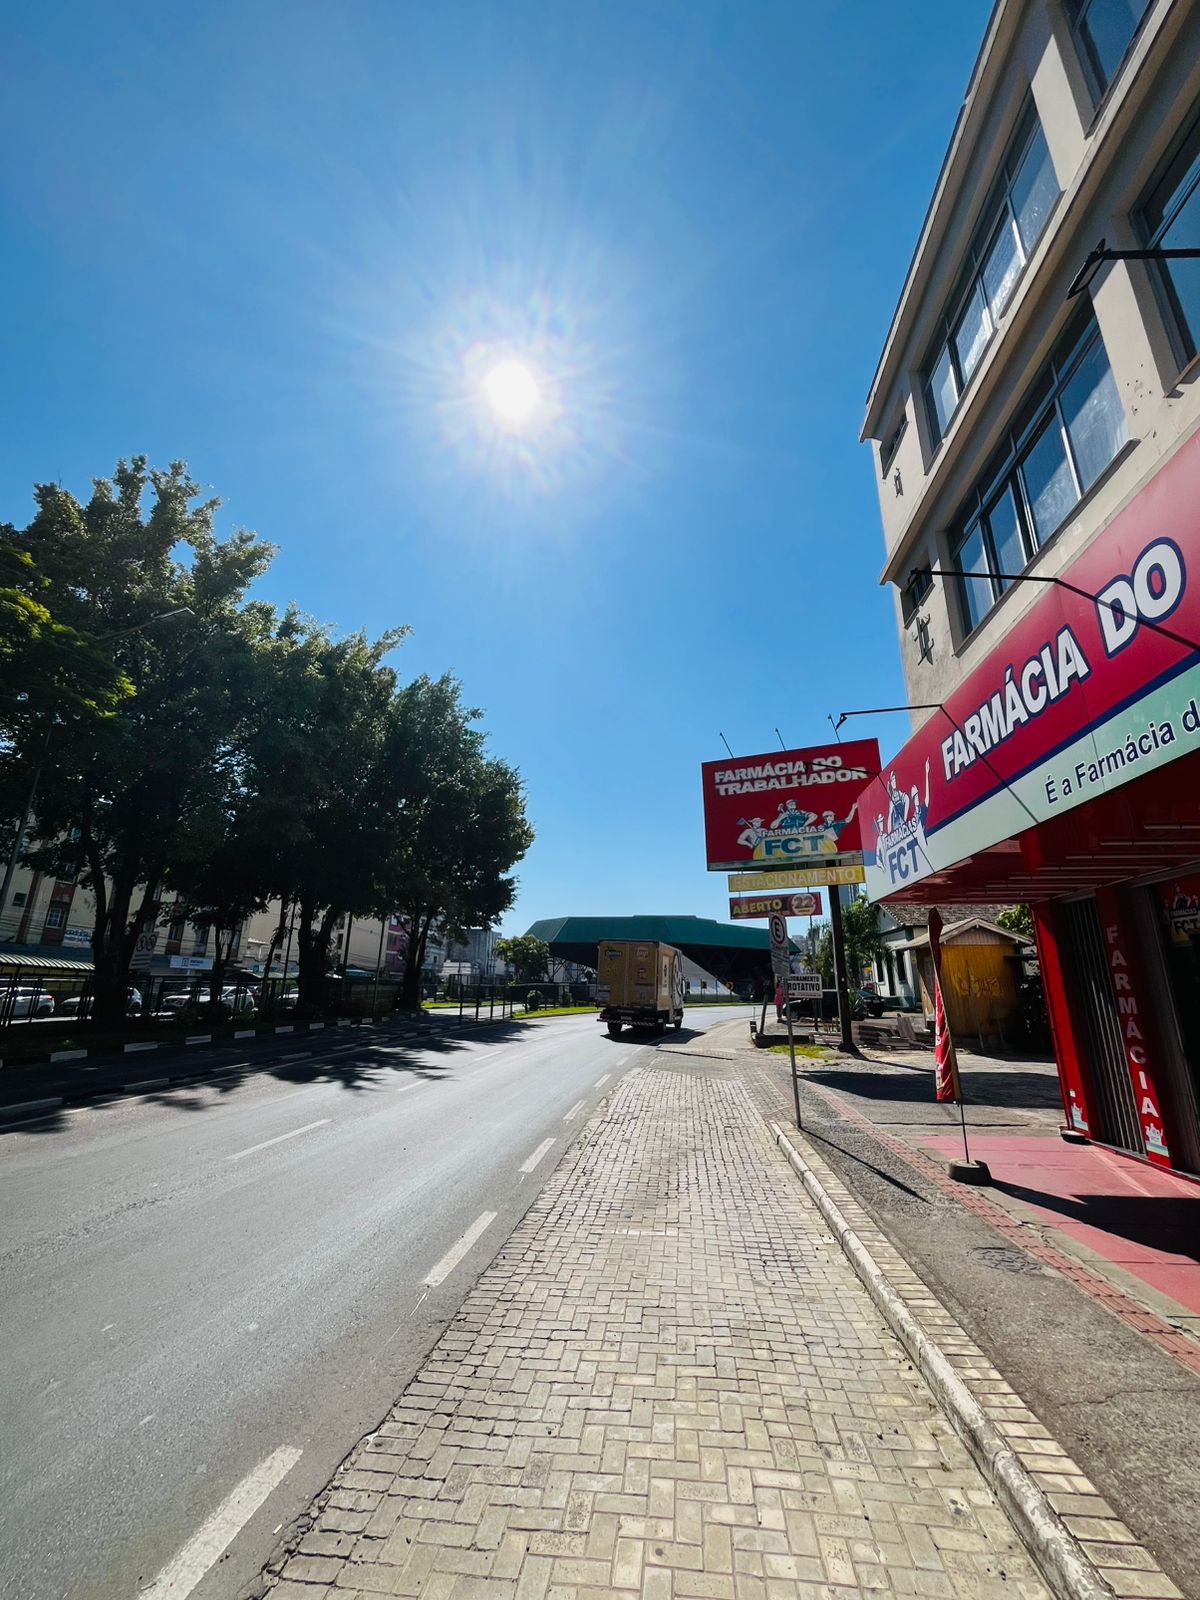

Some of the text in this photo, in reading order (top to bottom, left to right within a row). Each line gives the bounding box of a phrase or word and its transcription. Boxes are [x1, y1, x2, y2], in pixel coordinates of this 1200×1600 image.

[940, 540, 1184, 782] FARMÁCIA DO
[1045, 699, 1200, 803] É a Farmácia d
[714, 755, 842, 784] FARMÁCIA DO
[715, 767, 868, 796] TRABALHADOR
[764, 835, 825, 856] FCT
[888, 838, 919, 884] FCT
[735, 868, 856, 889] ESTACIONAMENTO
[732, 899, 782, 915] ABERTO
[774, 922, 781, 939] E
[1106, 926, 1159, 1118] FARMÁCIA
